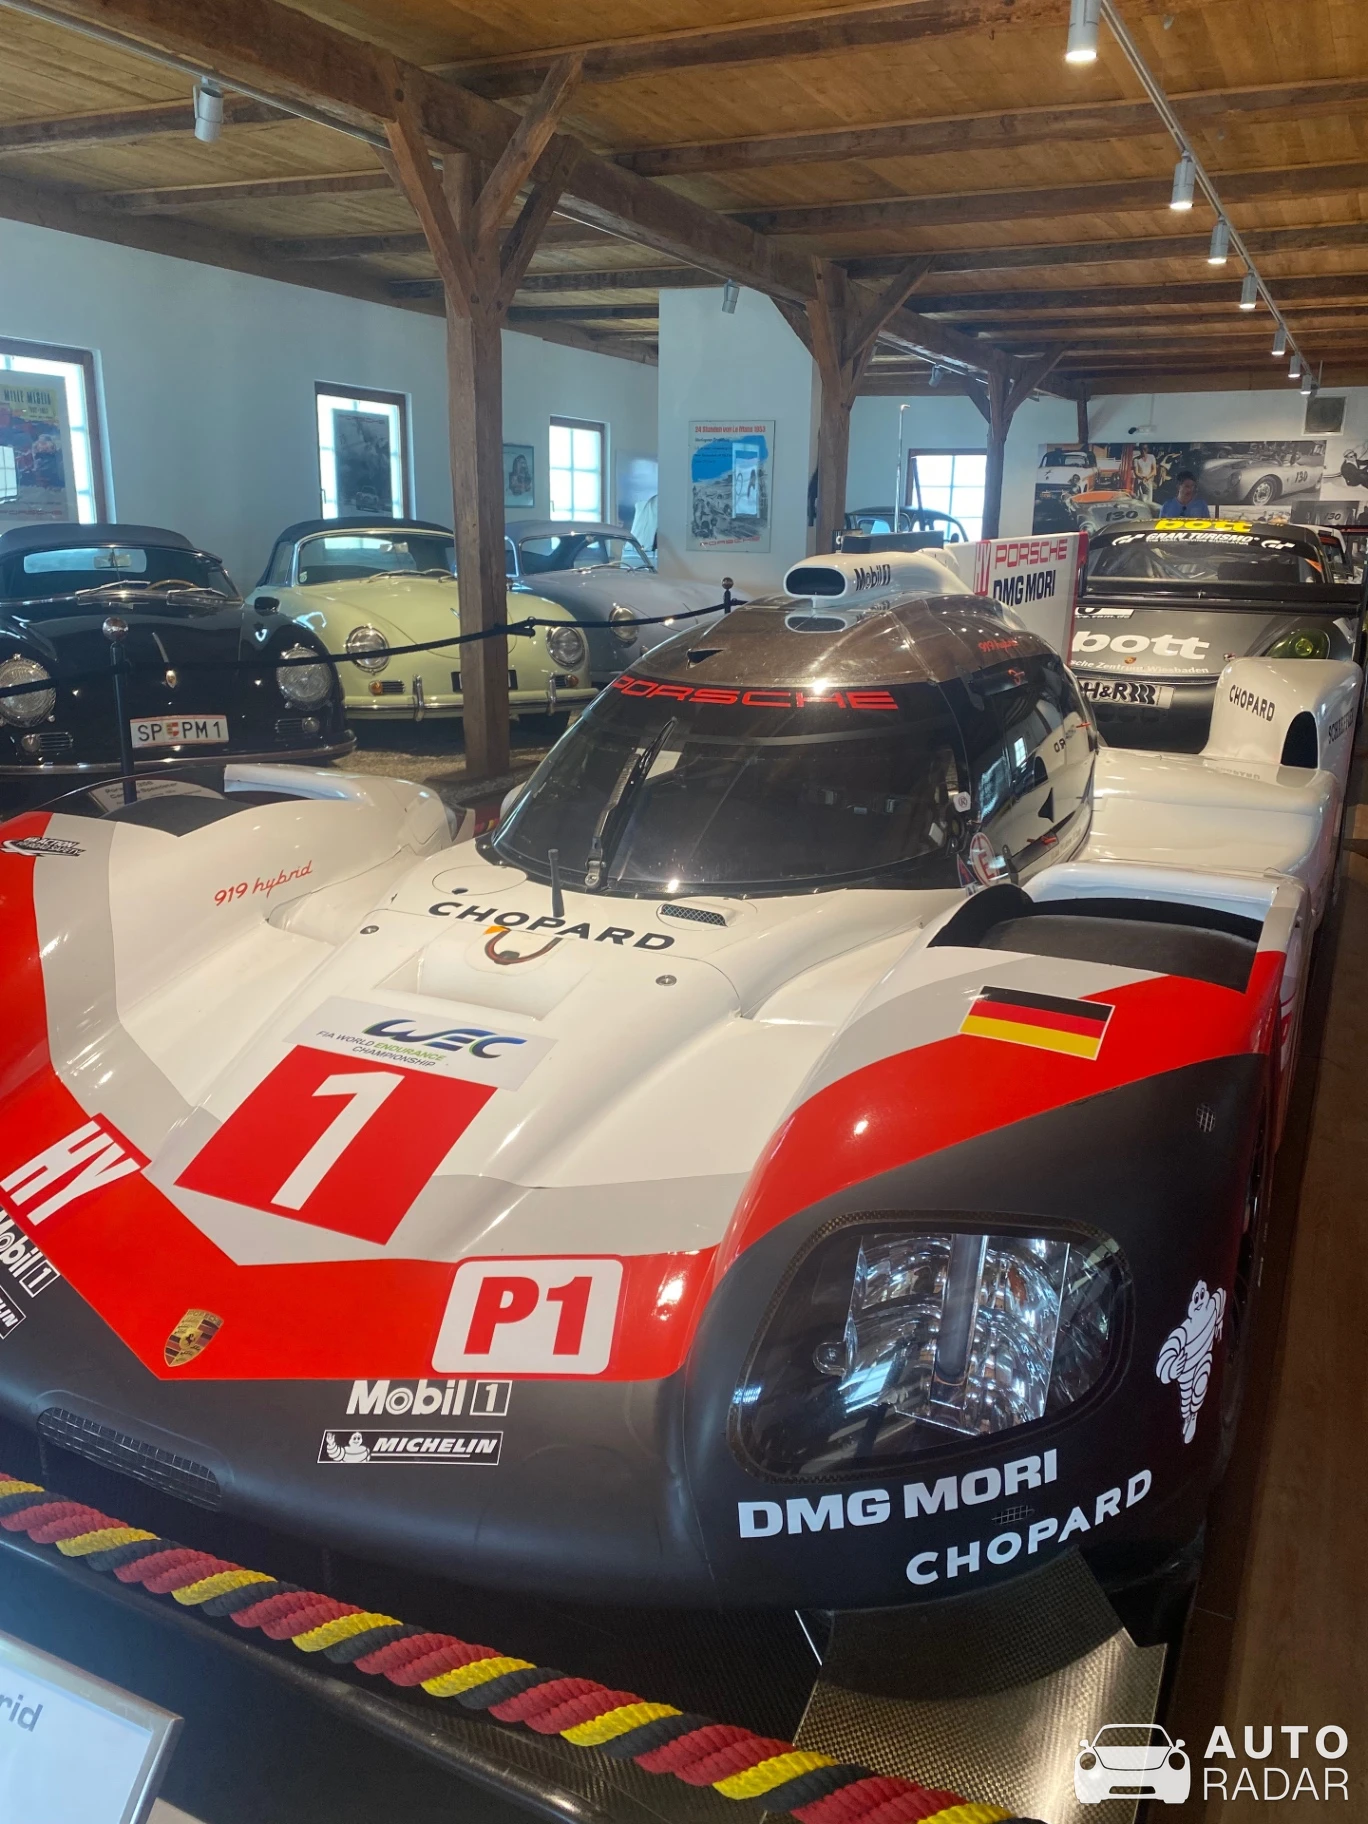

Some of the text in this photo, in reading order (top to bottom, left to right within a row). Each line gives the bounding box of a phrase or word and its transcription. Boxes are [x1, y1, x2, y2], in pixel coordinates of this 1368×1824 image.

[4, 389, 24, 403] MILLE
[1295, 471, 1309, 483] 130
[1105, 510, 1138, 522] 130
[1155, 520, 1253, 532] bott
[1324, 511, 1342, 521] 130
[1146, 532, 1185, 541] GRAN
[995, 539, 1067, 570] PORSCHE
[854, 565, 882, 591] Mobil
[993, 570, 1056, 607] DMG MORI
[1071, 631, 1210, 660] bott
[1070, 659, 1209, 674] sche Zentrum Wiesbaden
[612, 675, 898, 710] PORSCHE
[1229, 684, 1275, 721] CHOPARD
[138, 721, 220, 741] SP PM 1
[214, 860, 313, 906] 919 hybrid
[428, 902, 675, 950] CHOPARD
[316, 1030, 447, 1062] FIA WORLD ENDURANCE
[362, 1019, 527, 1059] WEC
[352, 1046, 436, 1067] CHAMPIONSHIP
[270, 1071, 405, 1211] 1
[0, 1120, 141, 1226] HY
[463, 1276, 593, 1356] P1
[345, 1380, 468, 1416] Mobil
[372, 1437, 498, 1454] MICHELIN
[737, 1448, 1058, 1538] DMG MORI
[906, 1469, 1152, 1586] CHOPARD
[0, 1694, 44, 1732] rid
